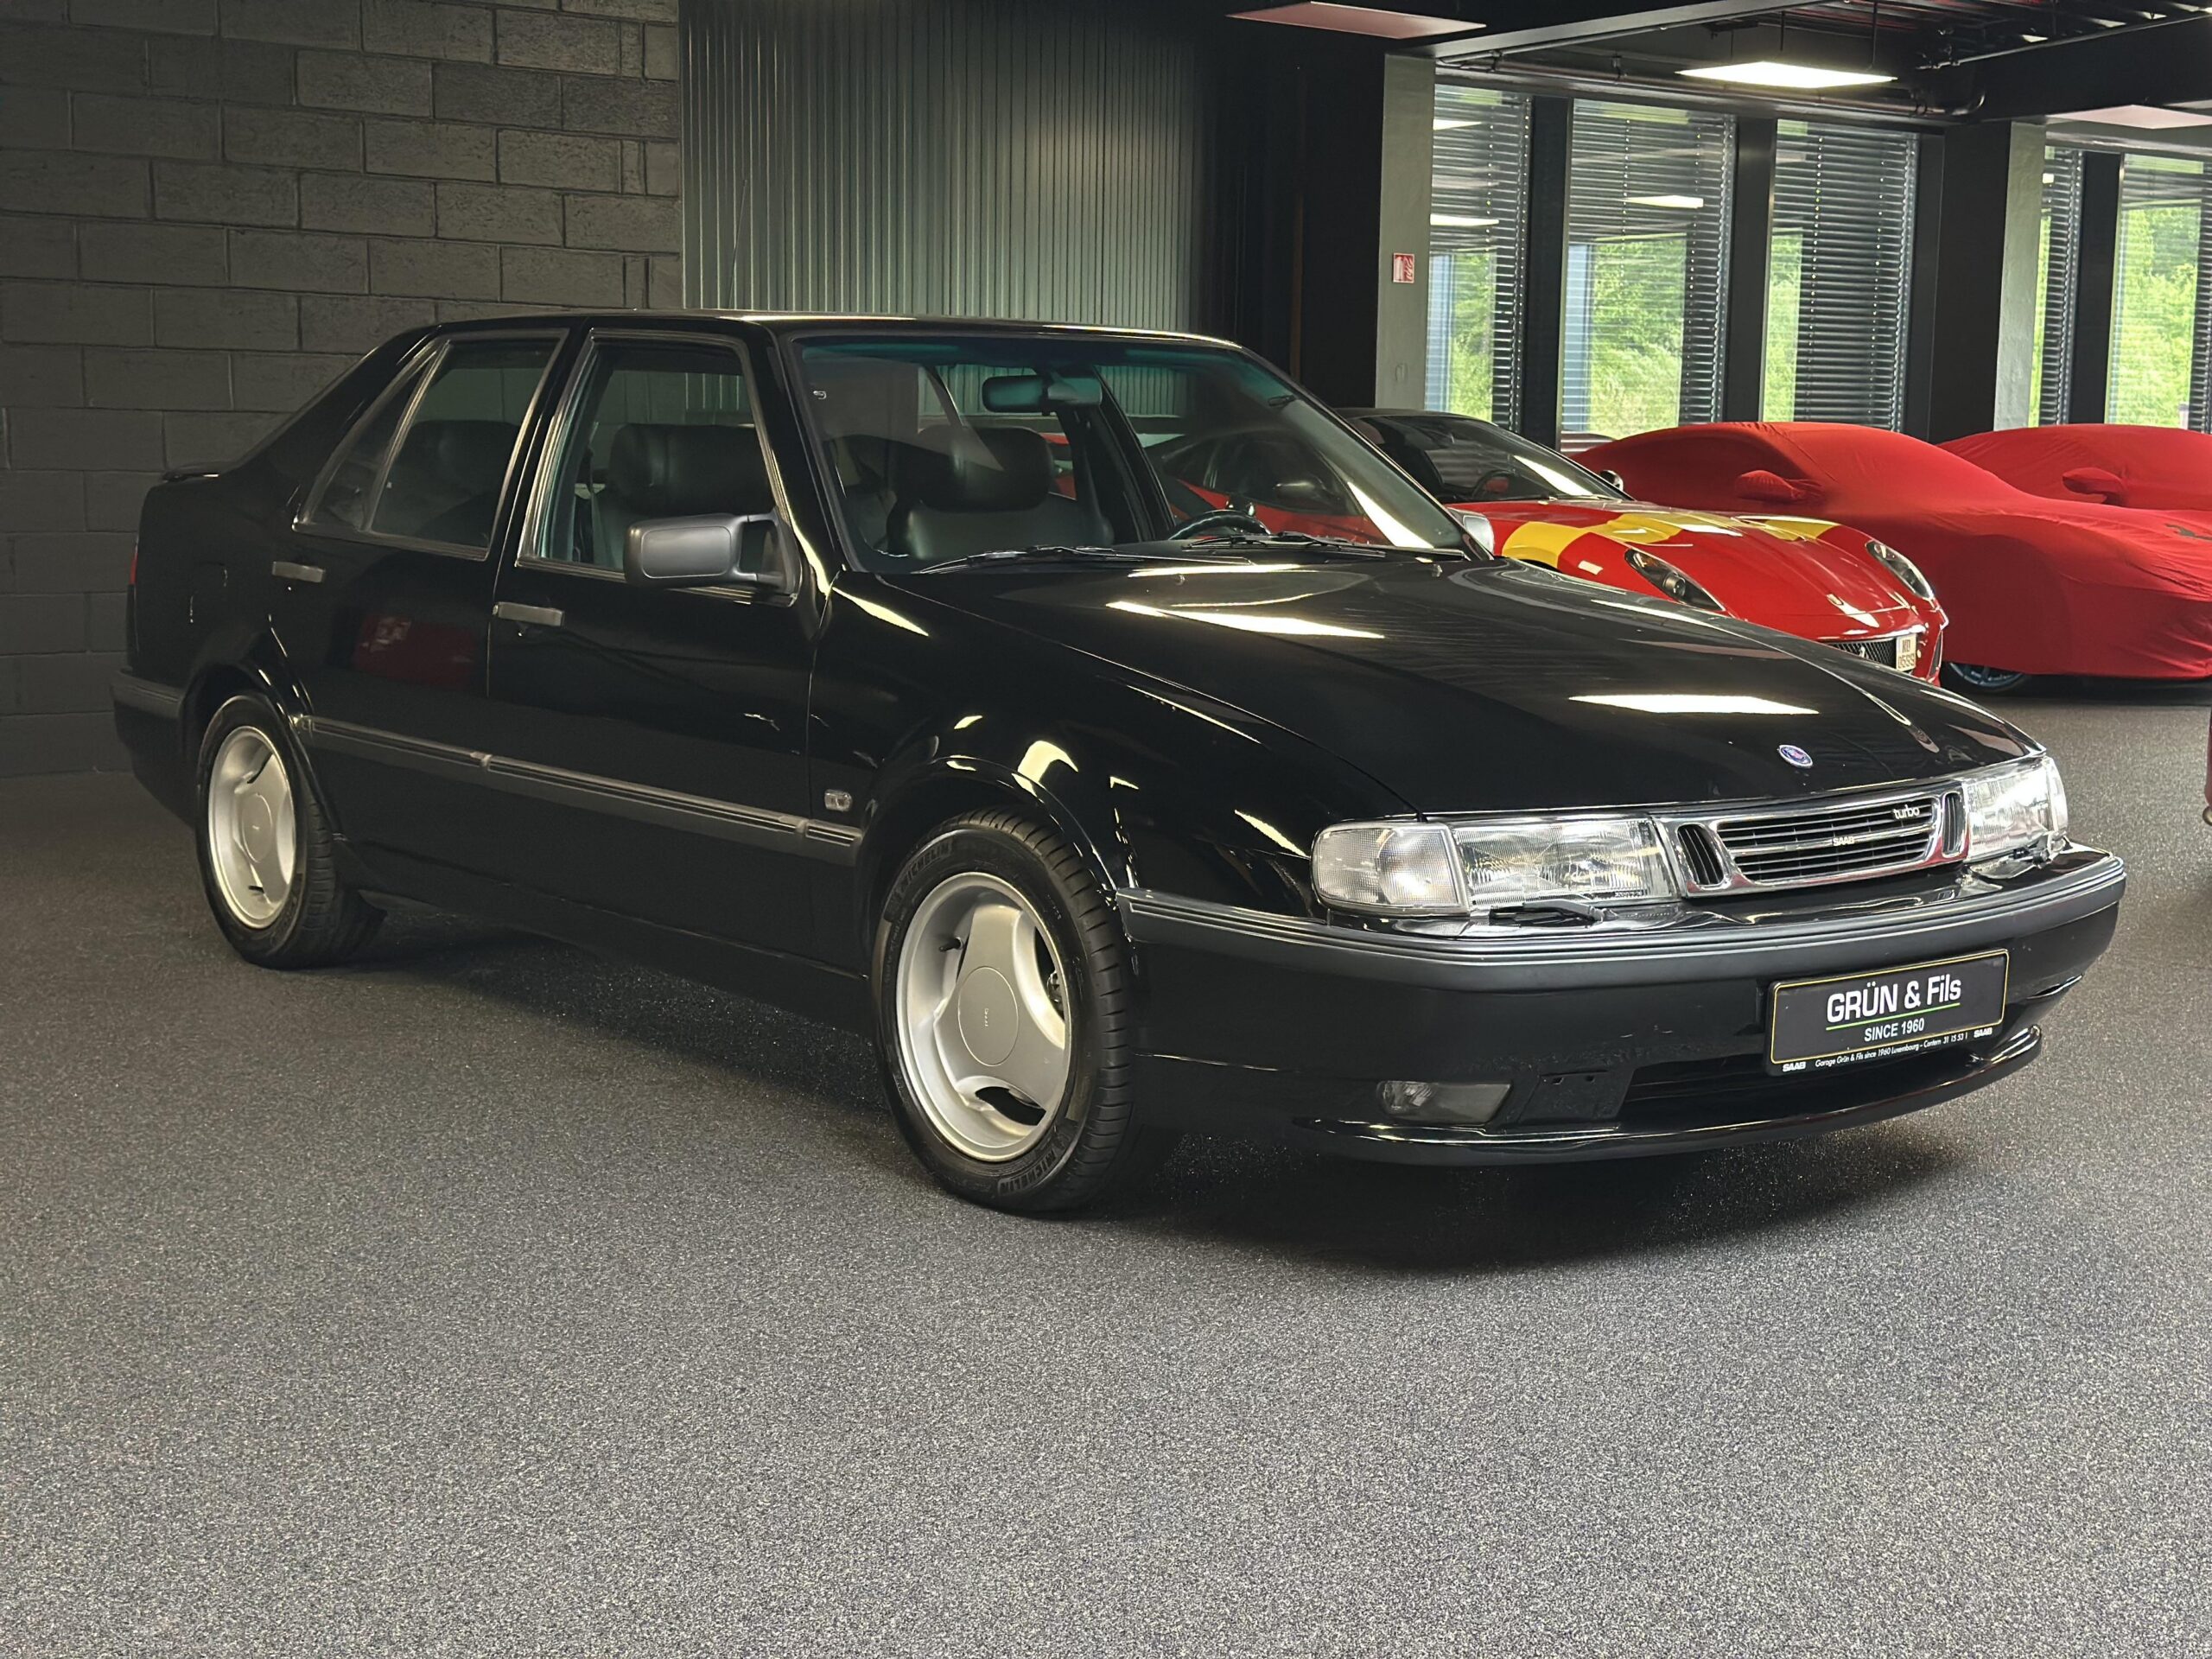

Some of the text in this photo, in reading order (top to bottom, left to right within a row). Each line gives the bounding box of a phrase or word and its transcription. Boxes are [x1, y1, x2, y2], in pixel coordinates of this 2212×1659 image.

[1893, 804, 1920, 819] turbo
[1833, 836, 1855, 847] SAAB
[1826, 974, 1961, 1023] GRÜN & Fils
[1865, 1018, 1925, 1042] SINCE 1960
[1974, 1027, 1993, 1038] SAAB
[1815, 1058, 1836, 1067] Garage
[1836, 1055, 1850, 1064] Grün
[1850, 1053, 1855, 1062] &
[1878, 1047, 1891, 1057] 1960
[1891, 1043, 1919, 1054] Luxembourg
[1783, 1062, 1806, 1071] SAAB
[999, 1149, 1057, 1195] MICHELIN
